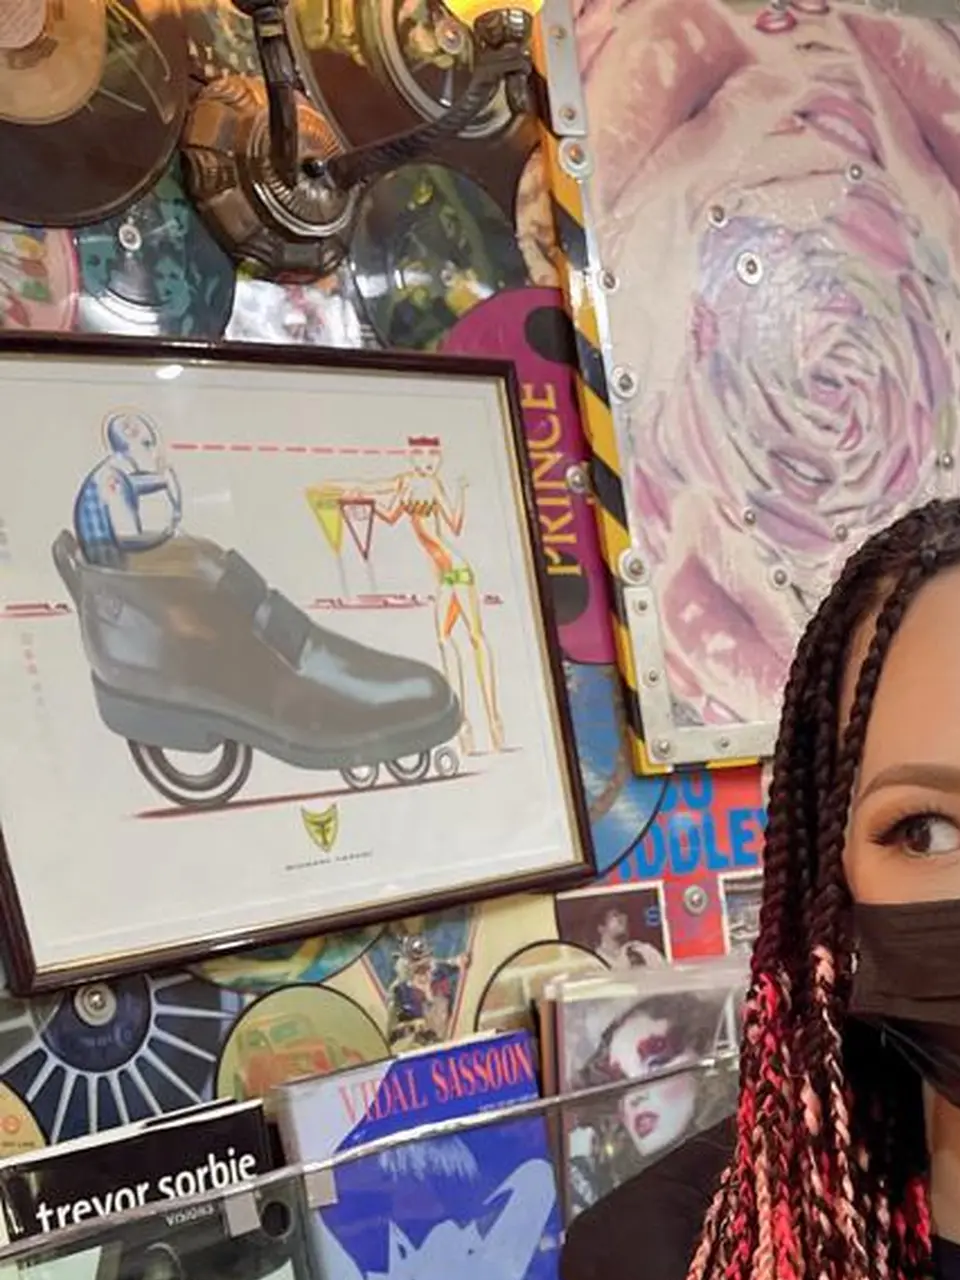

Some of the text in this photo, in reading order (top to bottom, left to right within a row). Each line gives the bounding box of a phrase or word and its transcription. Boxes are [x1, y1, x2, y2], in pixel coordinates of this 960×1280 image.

[521, 383, 582, 575] PRINCE
[338, 1042, 535, 1123] VIDAL SASSOON
[36, 1147, 258, 1233] trevor sorbie
